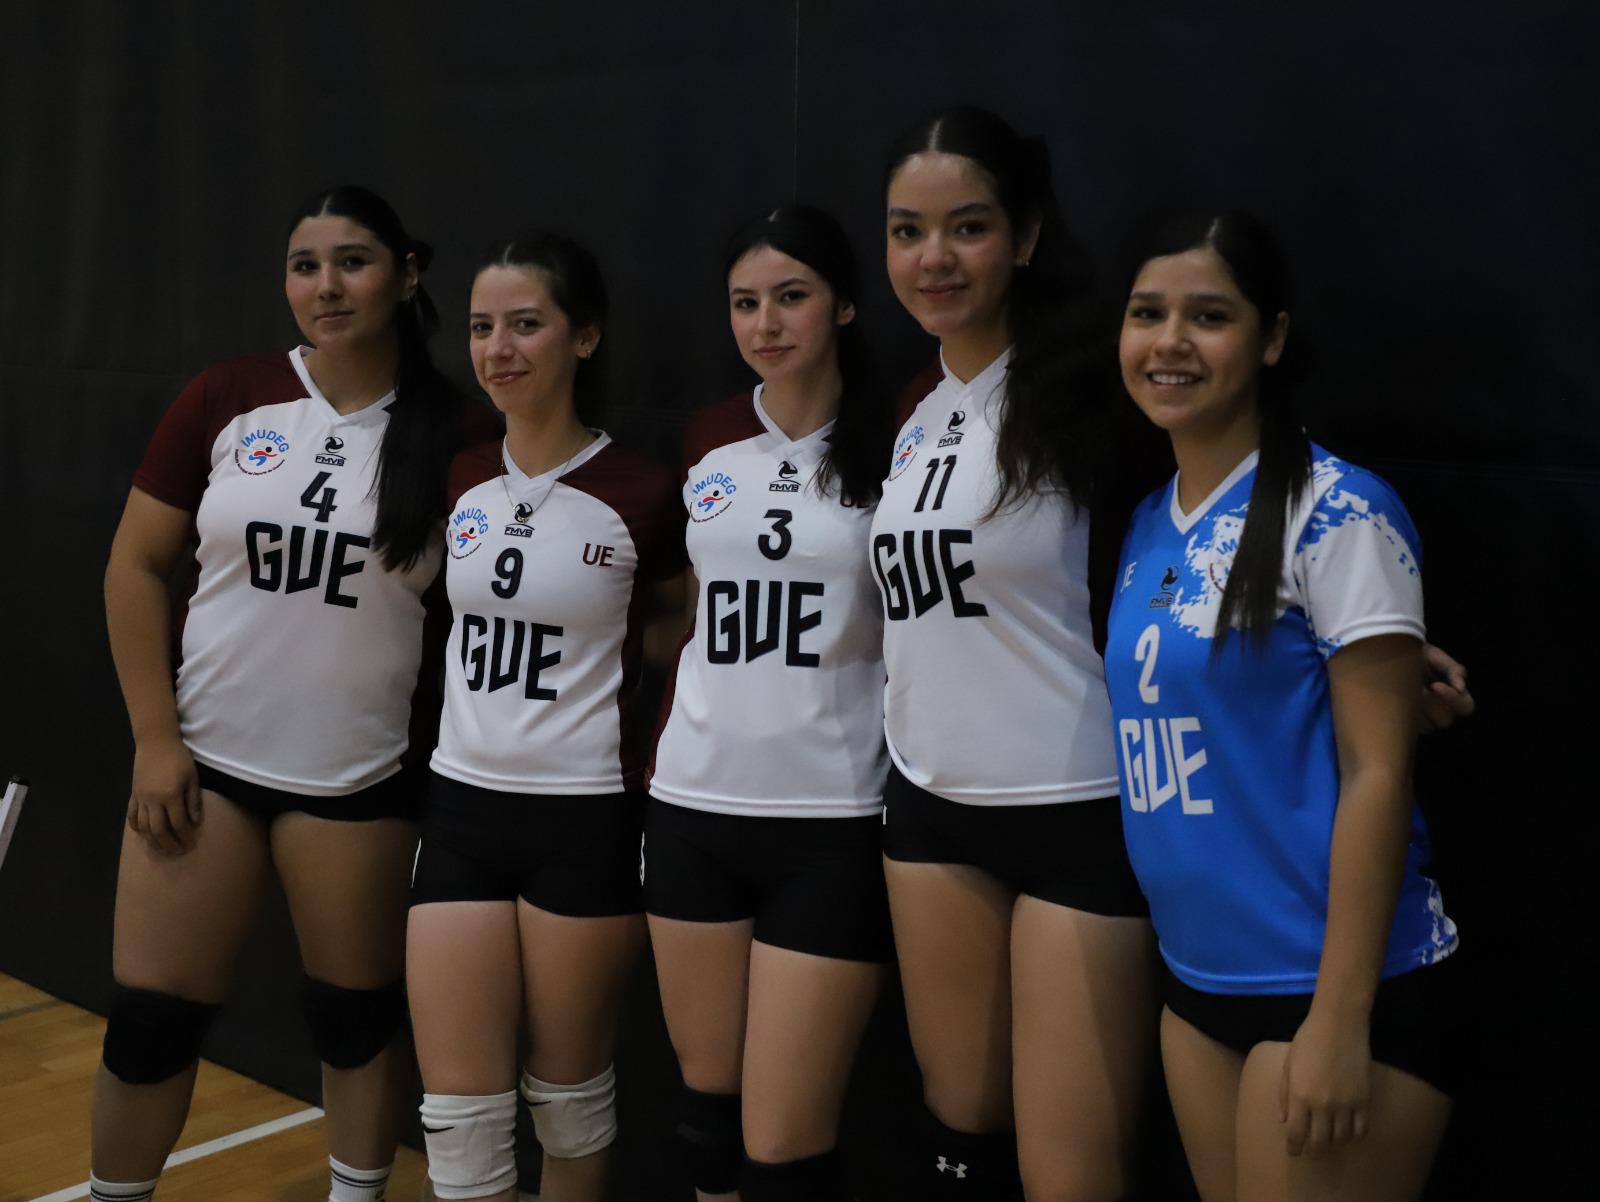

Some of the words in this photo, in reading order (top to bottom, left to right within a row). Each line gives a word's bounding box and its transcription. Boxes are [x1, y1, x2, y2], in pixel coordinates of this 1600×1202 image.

[241, 429, 290, 454] IMUDEG
[315, 455, 346, 467] FMVB
[300, 471, 338, 523] 4
[692, 472, 737, 495] IMUDEG
[768, 483, 800, 493] FMVB
[914, 454, 957, 513] 11
[453, 507, 489, 535] IMUDEG
[504, 526, 533, 538] FMVB
[757, 509, 793, 561] 3
[245, 521, 371, 609] GUE
[491, 547, 524, 600] 9
[582, 543, 615, 567] UE
[873, 528, 989, 621] GUE
[707, 579, 824, 668] GUE
[461, 613, 563, 701] GUE
[1134, 623, 1161, 704] 2
[1119, 716, 1214, 815] GUE
